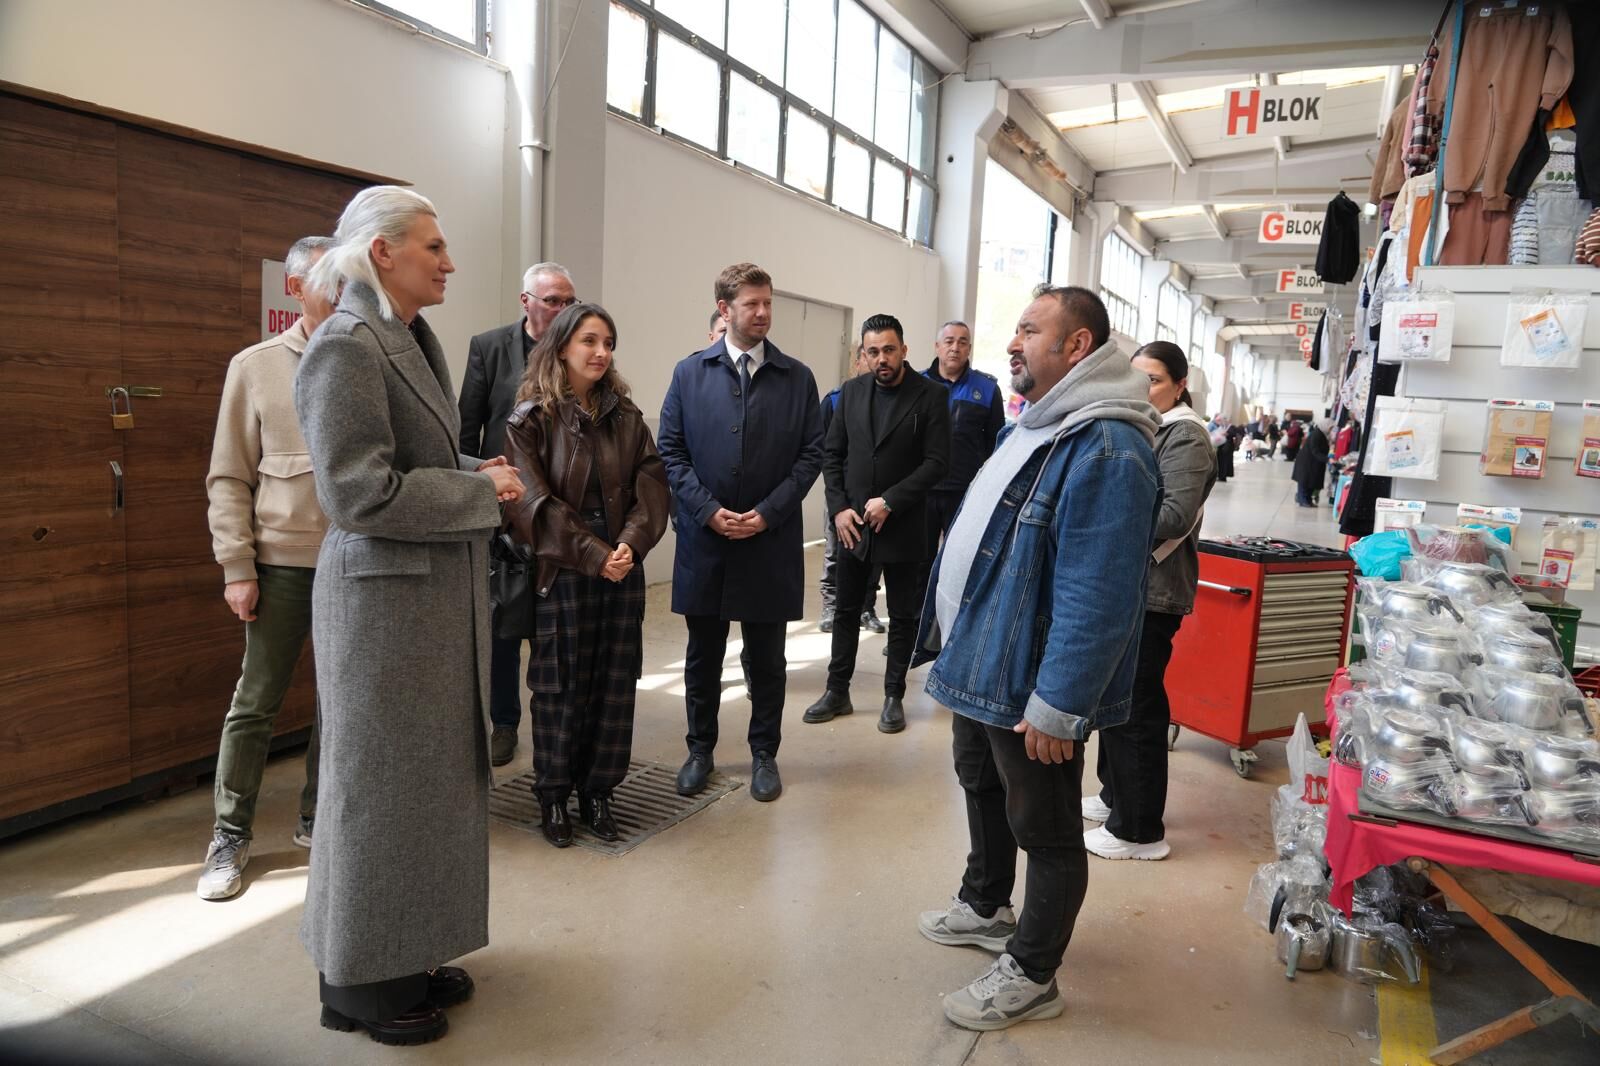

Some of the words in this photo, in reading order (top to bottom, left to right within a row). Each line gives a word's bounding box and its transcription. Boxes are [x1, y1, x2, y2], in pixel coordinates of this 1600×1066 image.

[1227, 90, 1260, 135] H
[1263, 97, 1321, 122] BLOK
[1263, 213, 1284, 241] G
[1286, 220, 1322, 235] BLOK
[1280, 271, 1296, 291] F
[1297, 275, 1323, 288] BLOK
[1291, 303, 1303, 320] E
